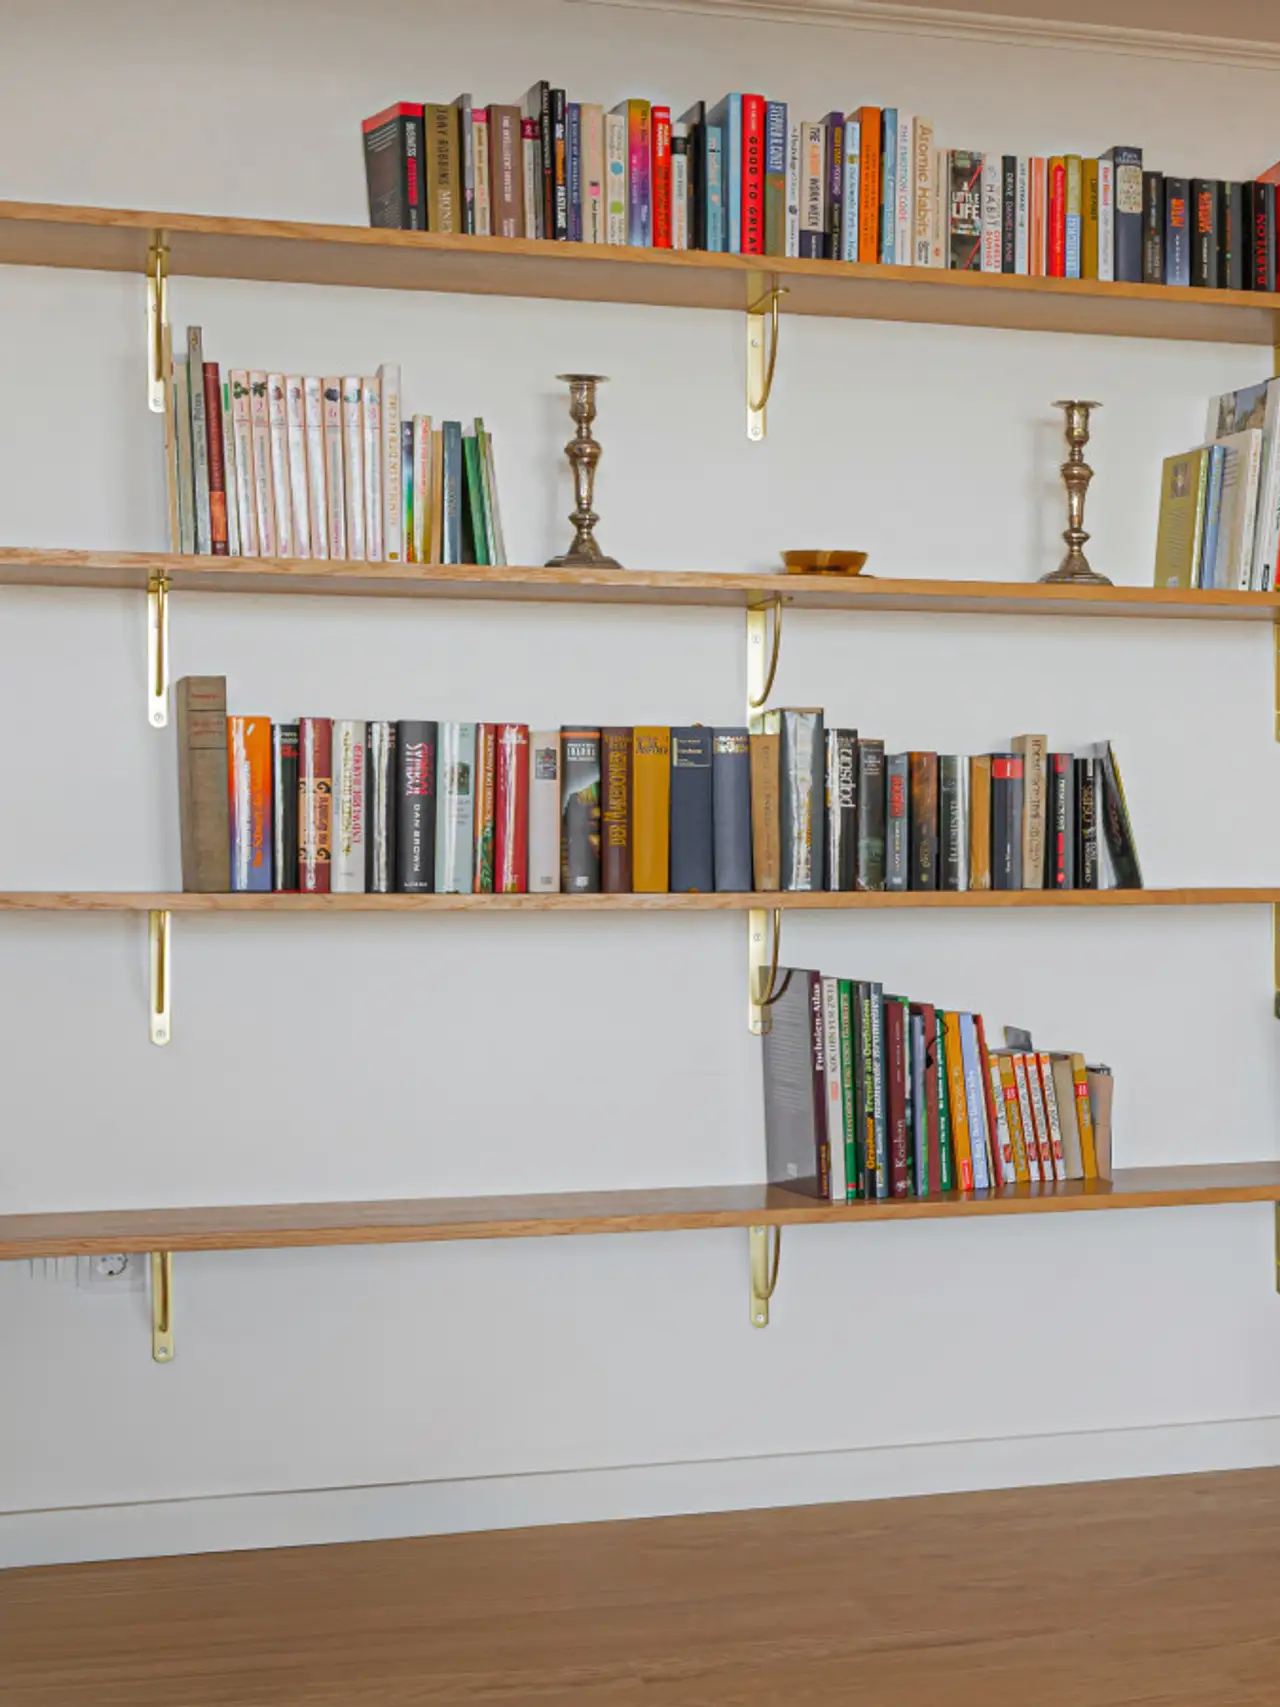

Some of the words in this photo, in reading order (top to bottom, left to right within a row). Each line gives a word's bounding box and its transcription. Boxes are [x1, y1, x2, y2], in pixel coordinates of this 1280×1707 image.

[748, 136, 758, 175] GOOD
[917, 124, 933, 182] Atomic
[748, 183, 758, 201] TO
[916, 186, 932, 237] Habits
[985, 183, 997, 226] HABIT
[413, 803, 422, 828] DAN
[608, 824, 627, 847] DER
[413, 830, 422, 872] BROWN
[814, 983, 827, 1073] Fuchsien-Atlas
[895, 1119, 906, 1170] Kochen
